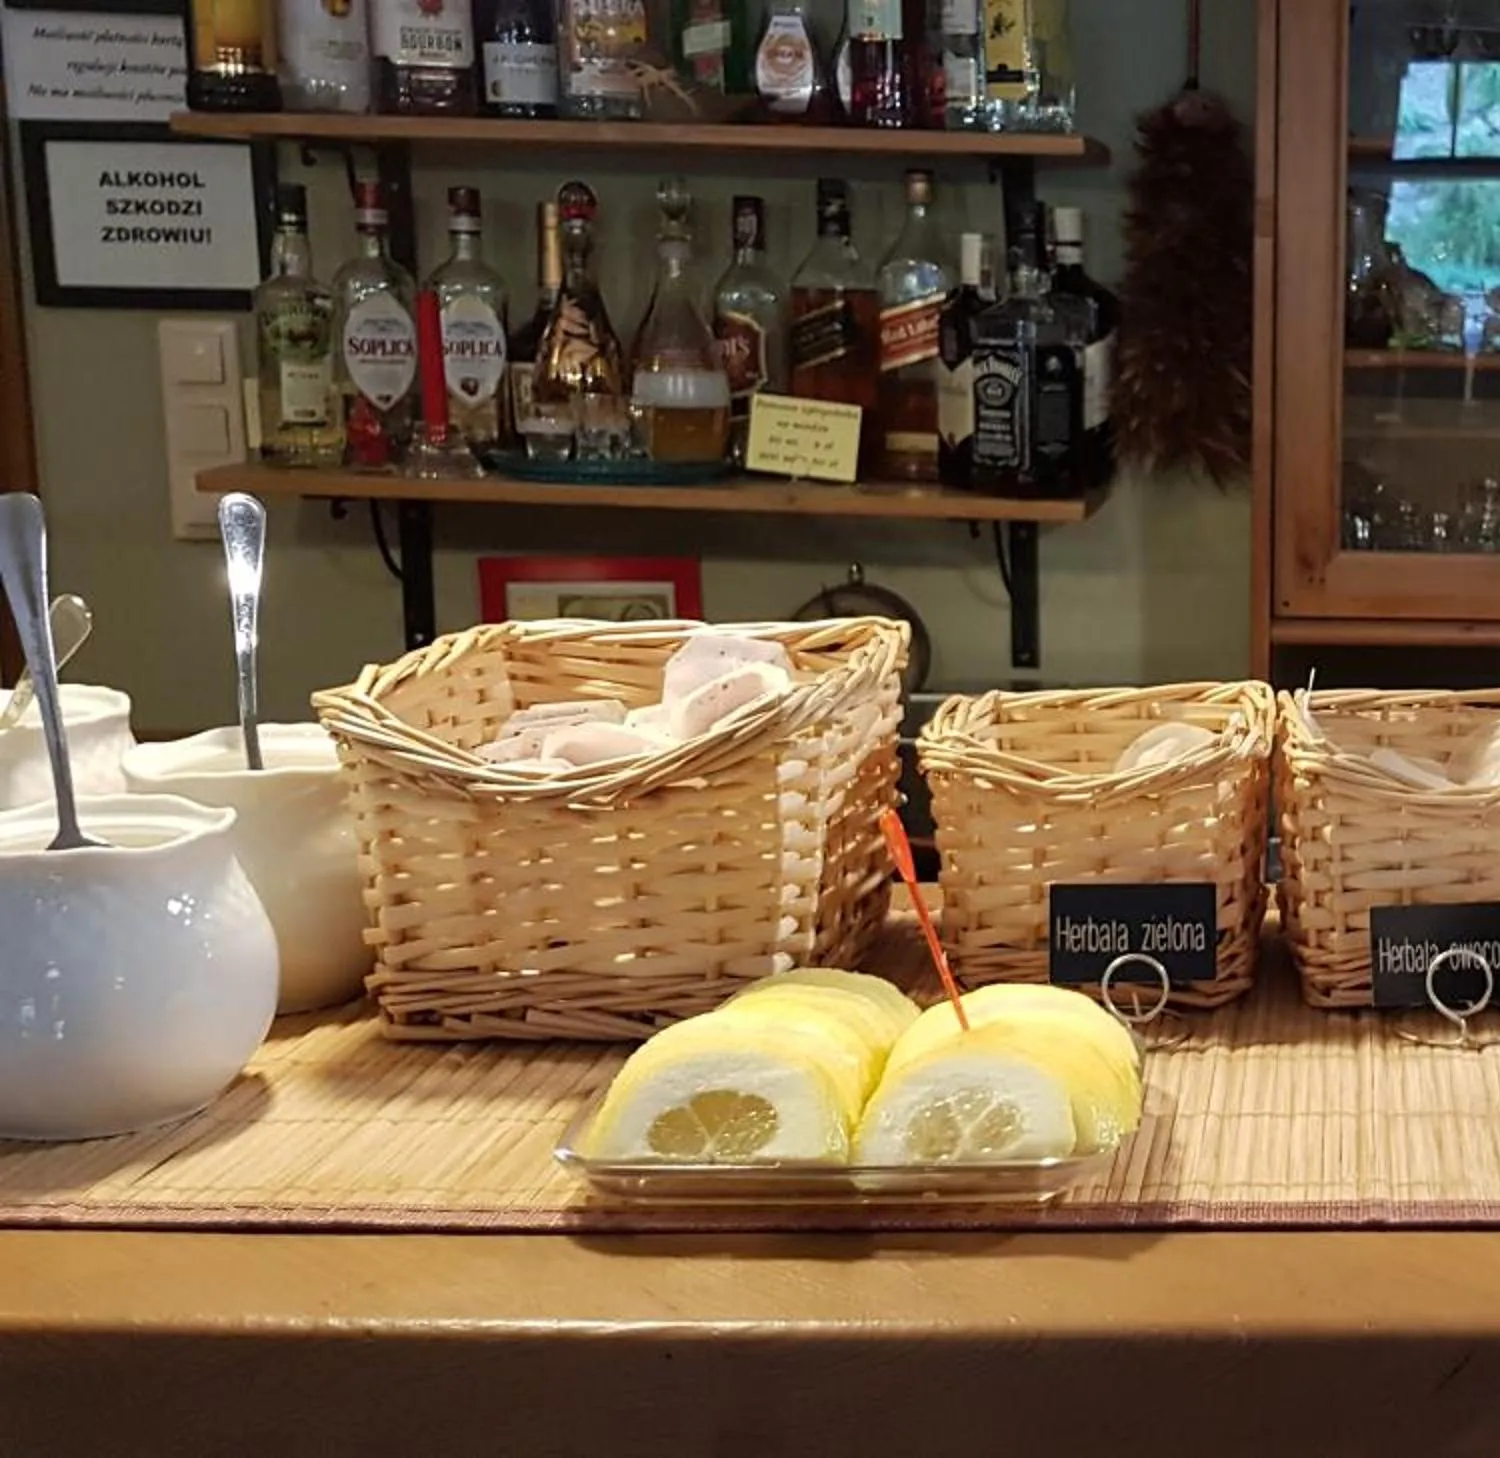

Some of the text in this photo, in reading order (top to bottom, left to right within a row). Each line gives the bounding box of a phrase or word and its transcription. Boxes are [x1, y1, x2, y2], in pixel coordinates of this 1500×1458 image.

[99, 171, 206, 188] ALKOHOL
[105, 199, 203, 216] SZKODZI
[101, 227, 212, 244] ZDROWIU!
[349, 336, 415, 355] SOPLICA
[1055, 914, 1206, 954] Herbata zielona
[1377, 936, 1440, 974] Herbata
